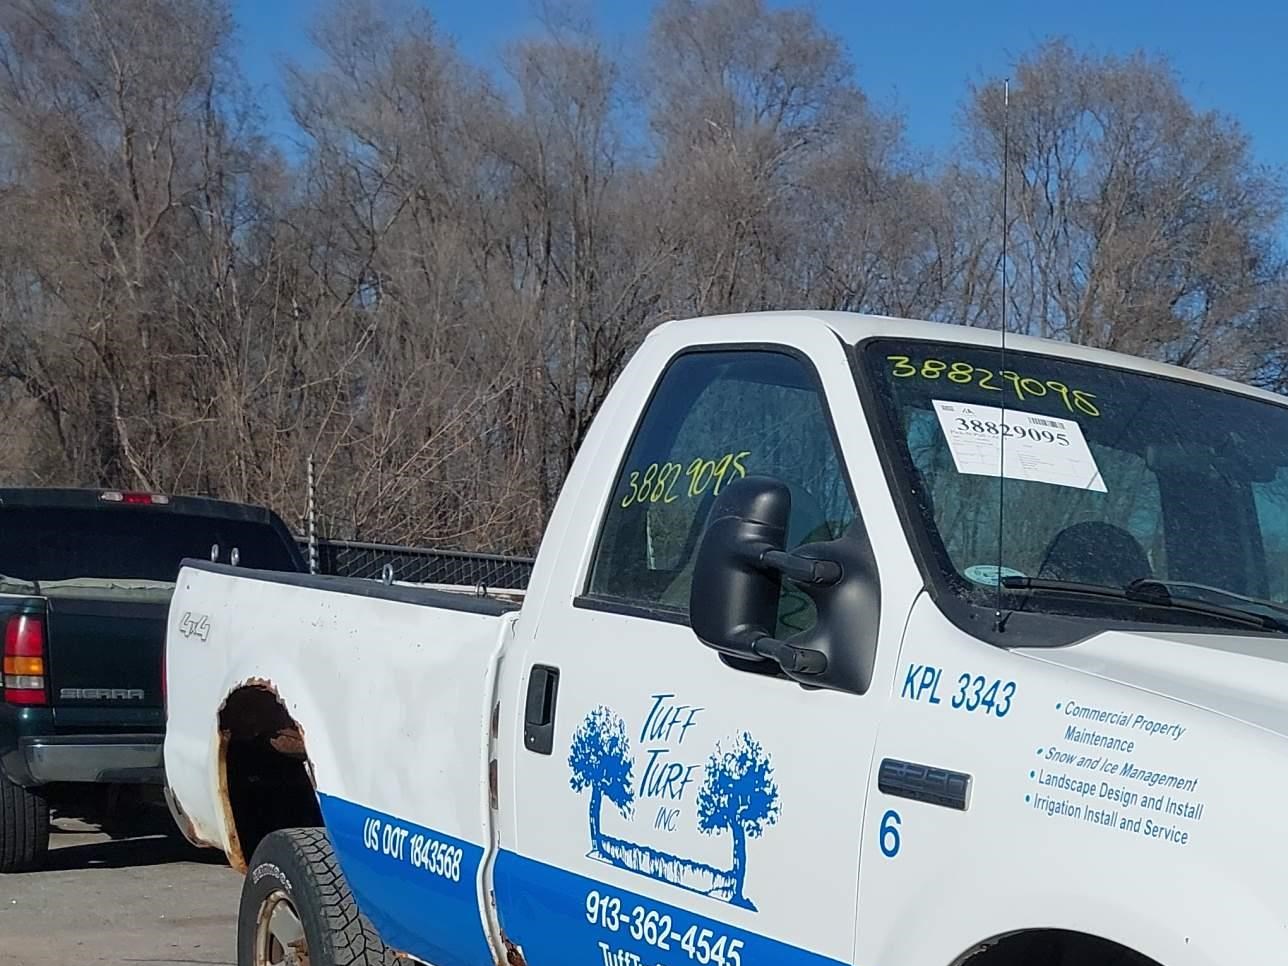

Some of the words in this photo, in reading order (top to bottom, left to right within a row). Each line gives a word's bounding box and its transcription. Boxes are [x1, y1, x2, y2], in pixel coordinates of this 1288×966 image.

[886, 355, 1101, 417] 38829095
[954, 416, 1071, 448] 38829095
[179, 611, 211, 642] 4x4
[59, 687, 145, 700] SIERRA
[901, 663, 943, 705] KPL
[951, 672, 1017, 718] 3343
[1063, 724, 1135, 753] Maintenance
[1064, 700, 1133, 727] Commercial
[1132, 714, 1186, 741] Property
[1044, 746, 1078, 765] Snow
[1076, 755, 1101, 770] and
[1100, 757, 1119, 775] Ice
[1119, 762, 1199, 793] Management
[1033, 792, 1082, 818] Irrigation
[1083, 804, 1119, 828] Install
[1119, 817, 1142, 833] and
[1143, 819, 1189, 845] Service
[1038, 768, 1097, 798] Landscape
[1099, 781, 1138, 808] Design
[1140, 794, 1163, 811] and
[1165, 796, 1205, 821] Install
[363, 817, 381, 851] US
[409, 833, 463, 882] 1843568
[879, 809, 901, 858] 6
